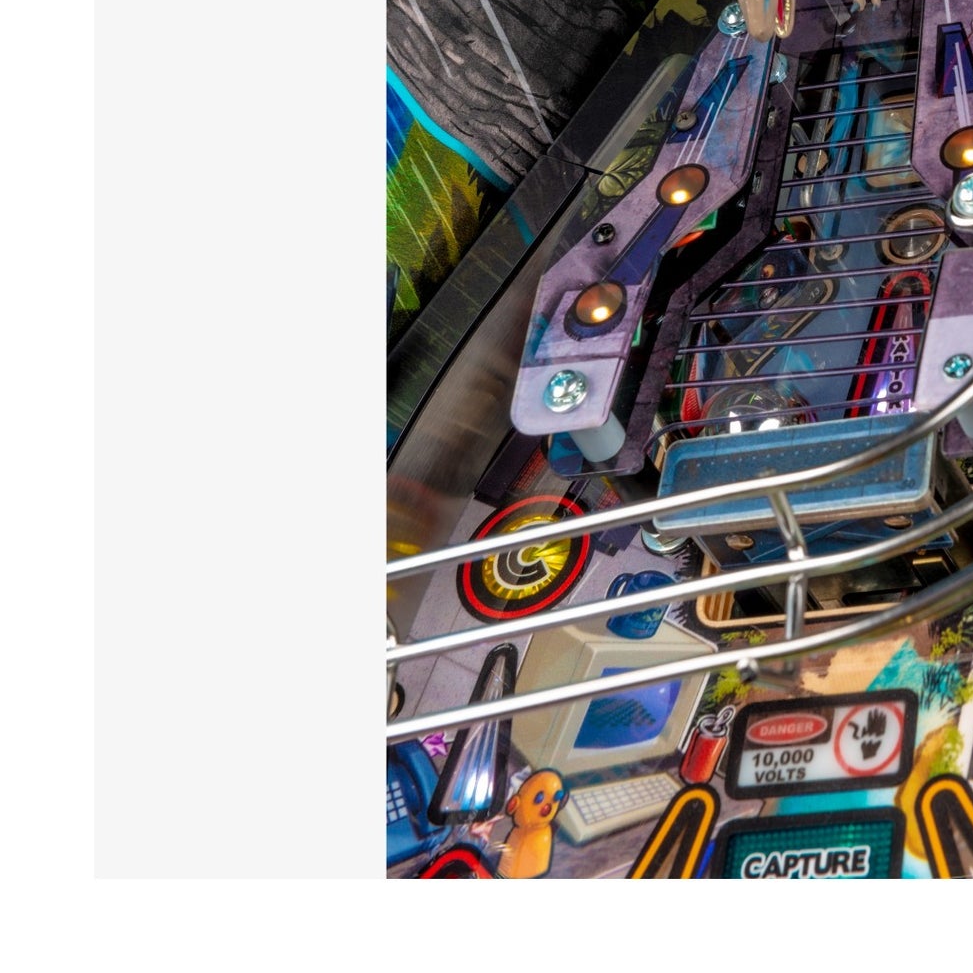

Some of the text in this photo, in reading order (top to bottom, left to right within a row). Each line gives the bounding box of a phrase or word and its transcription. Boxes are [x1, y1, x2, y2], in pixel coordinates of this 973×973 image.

[759, 721, 814, 737] DANGER
[752, 748, 814, 770] 10,000
[754, 767, 807, 783] VOLTS
[742, 847, 870, 879] CAPTURE
